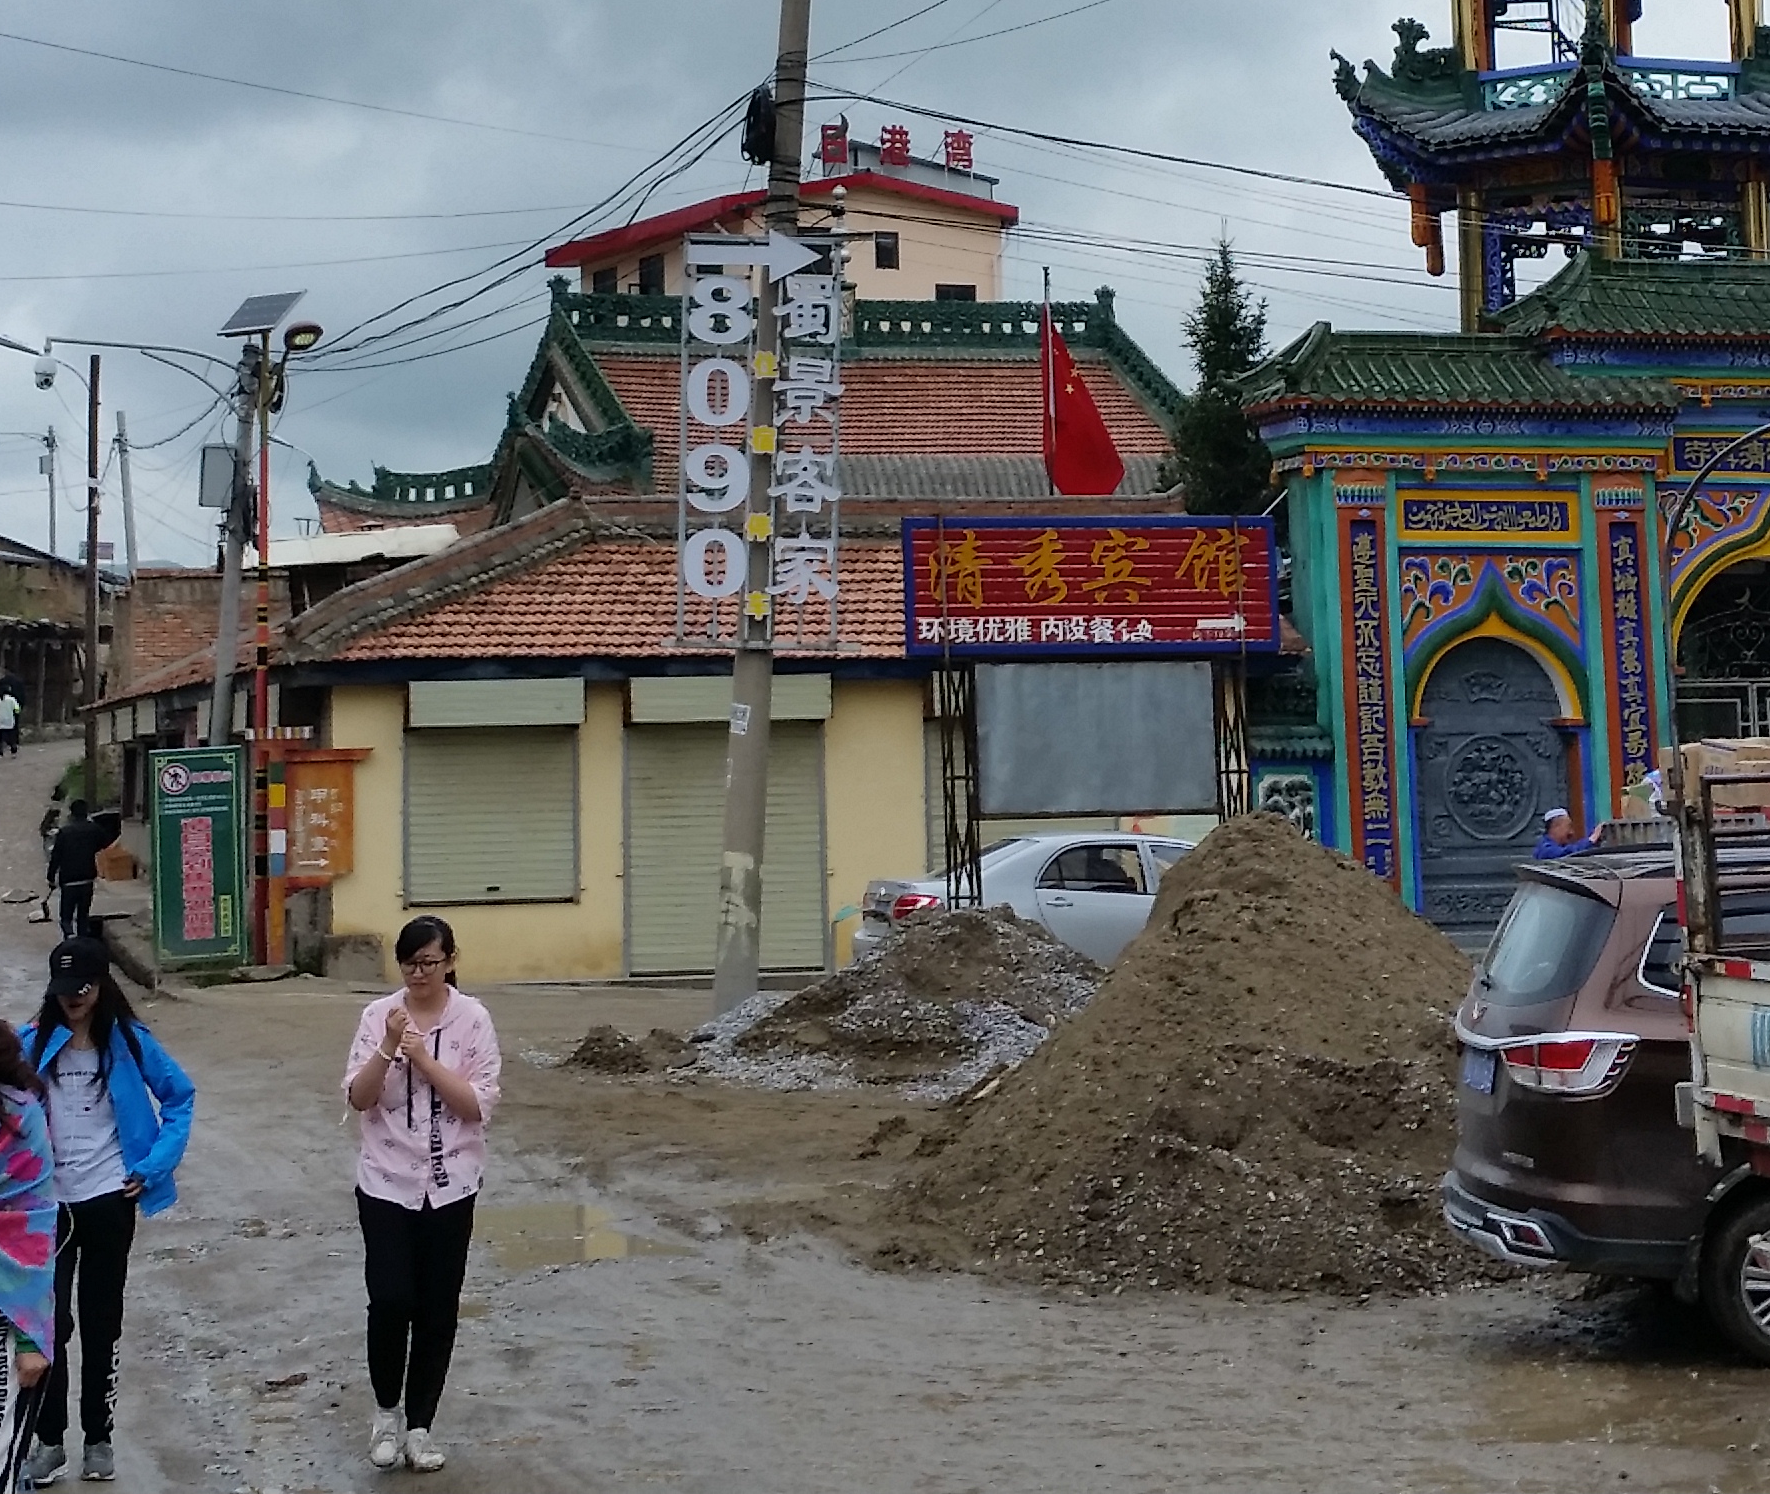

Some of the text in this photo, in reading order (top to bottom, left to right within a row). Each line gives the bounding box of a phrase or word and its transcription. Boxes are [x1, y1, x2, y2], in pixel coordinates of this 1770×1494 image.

[682, 276, 752, 598] 8090
[765, 274, 846, 604] 蜀景客家
[918, 616, 1032, 645] 环境优雅
[929, 529, 1249, 610] 清秀宾馆
